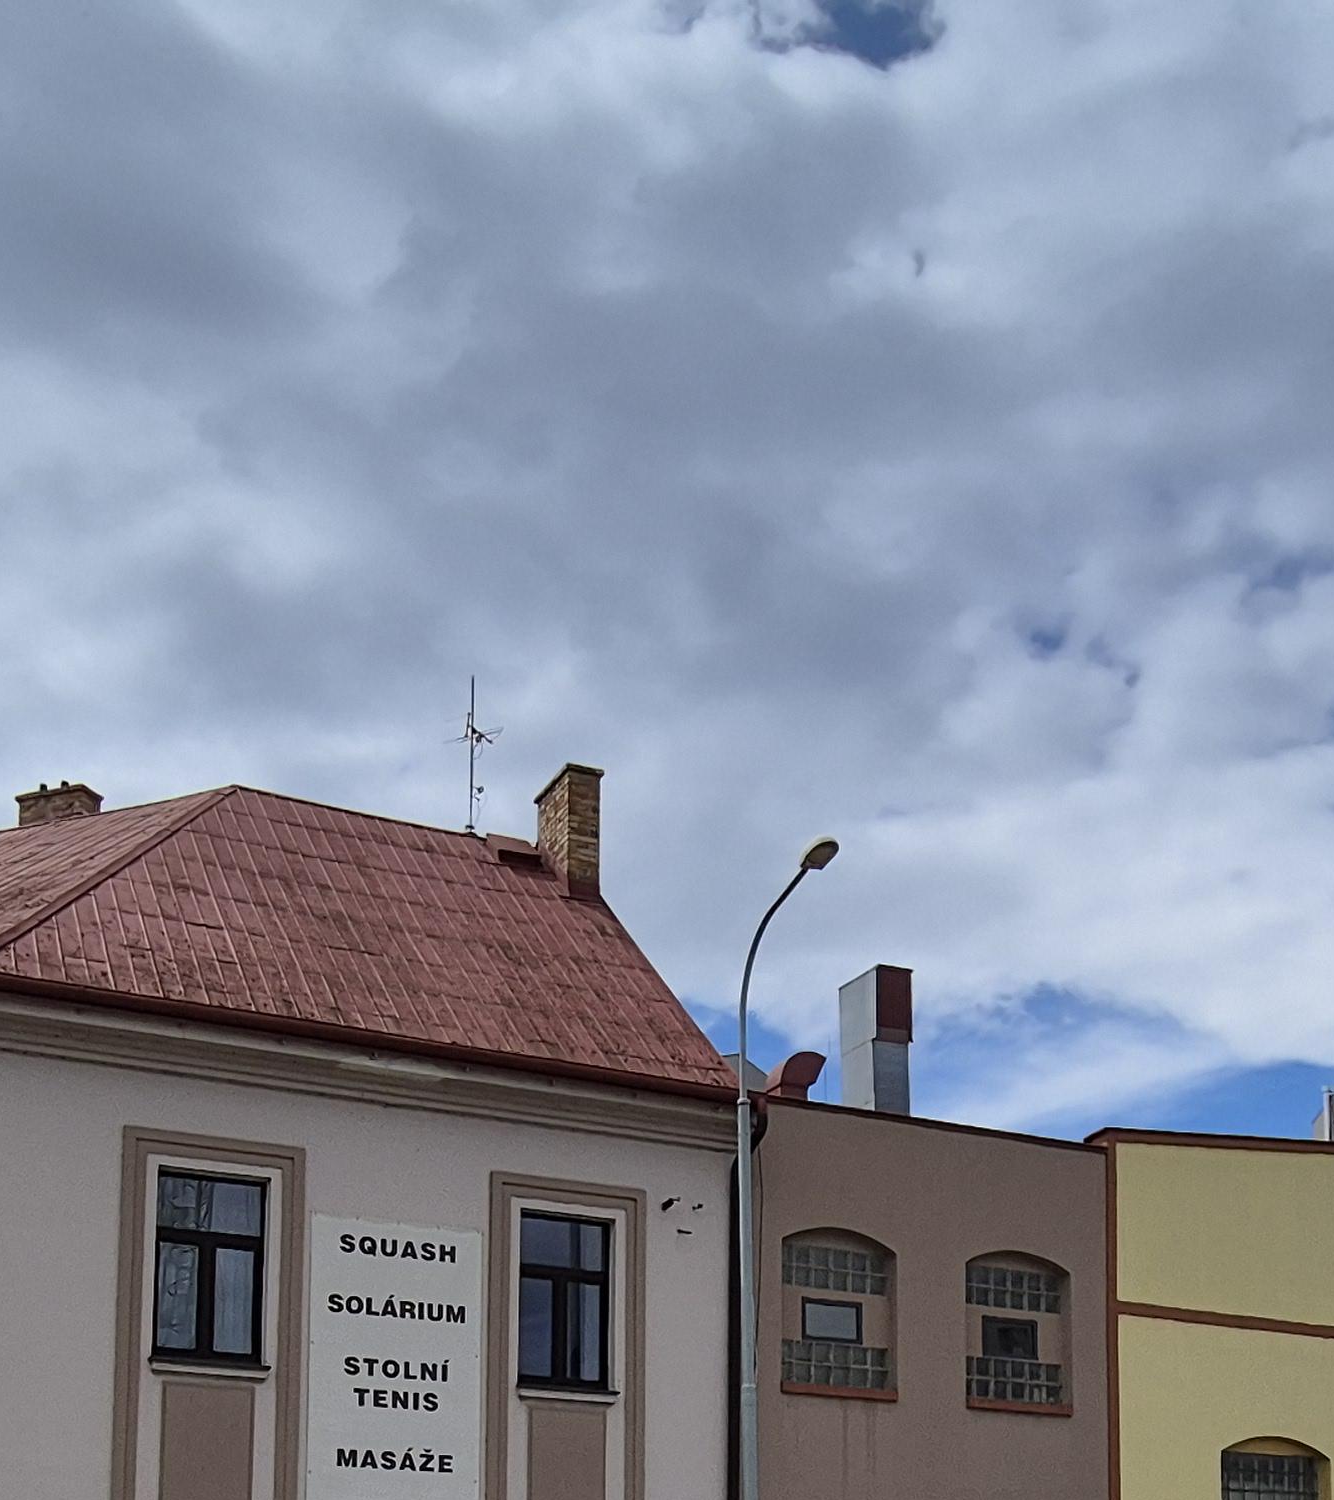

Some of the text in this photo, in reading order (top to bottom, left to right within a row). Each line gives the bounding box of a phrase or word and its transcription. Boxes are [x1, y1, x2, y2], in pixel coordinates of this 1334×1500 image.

[339, 1233, 457, 1264] SQUASH
[327, 1292, 466, 1324] SOLÁRIUM
[343, 1356, 451, 1383] STOLNÍ
[353, 1386, 440, 1412] TENIS
[336, 1447, 455, 1474] MASÁŽE
